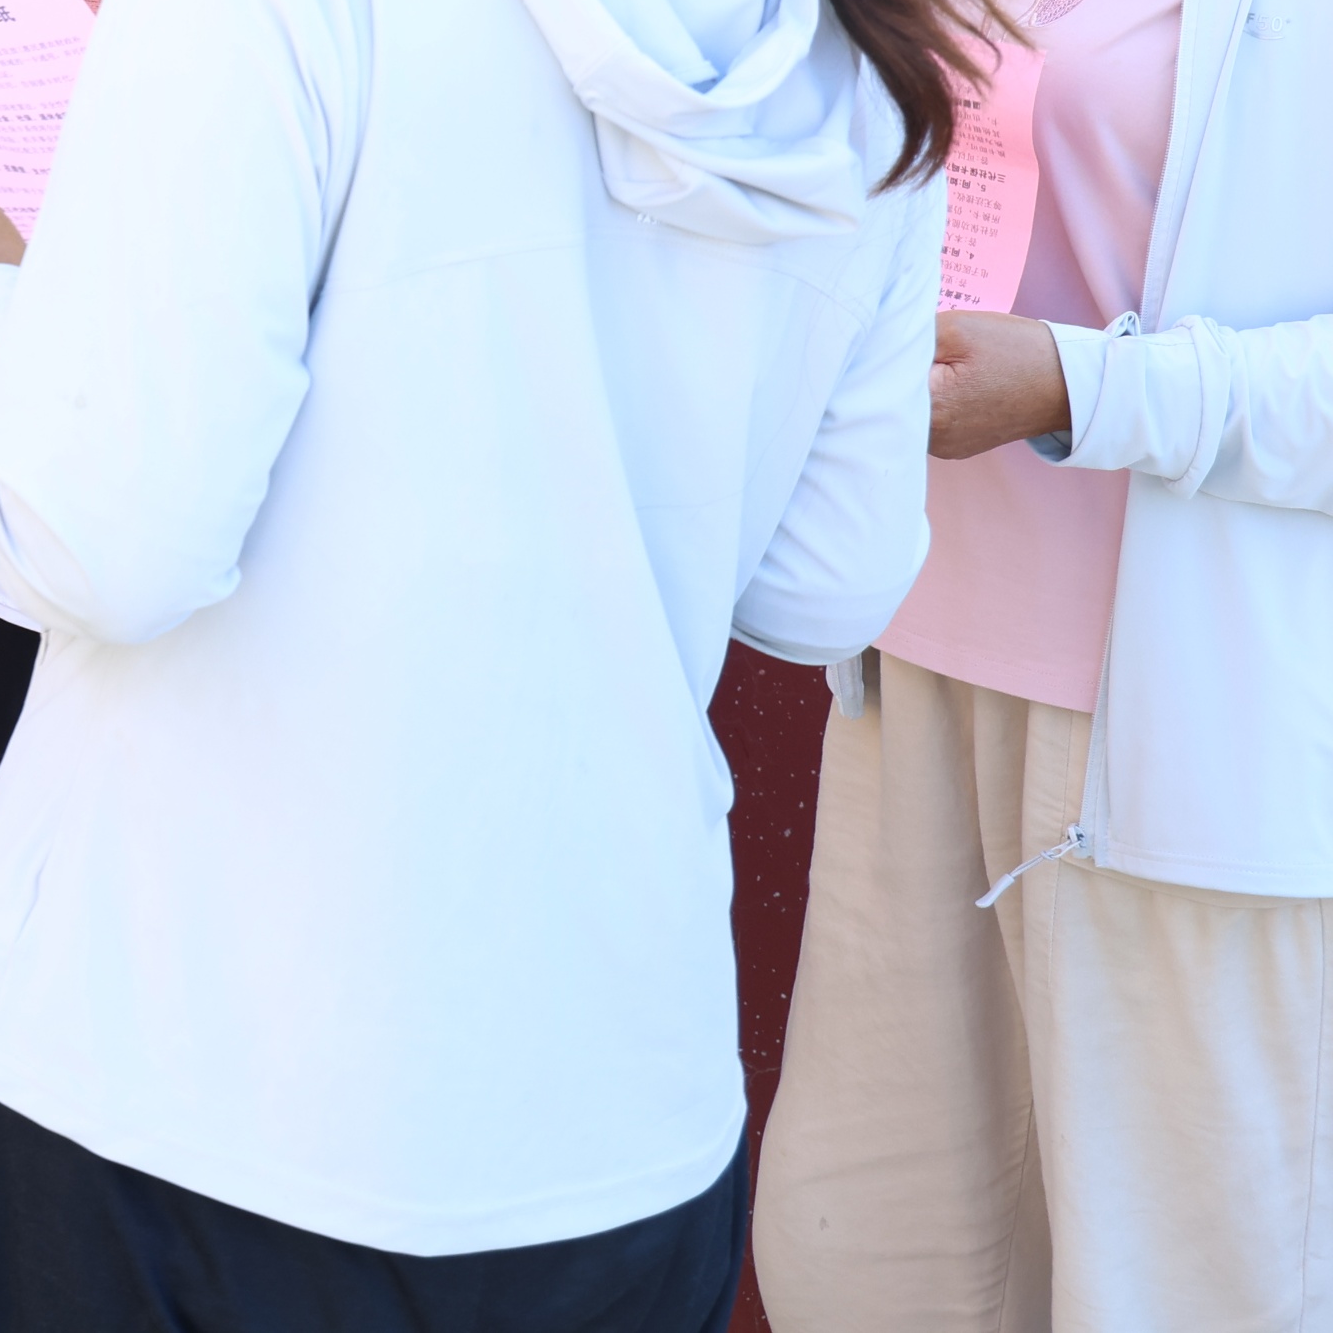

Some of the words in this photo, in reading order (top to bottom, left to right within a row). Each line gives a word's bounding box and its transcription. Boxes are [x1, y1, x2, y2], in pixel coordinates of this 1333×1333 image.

[947, 163, 1006, 183] 三代社保卡吗?
[947, 176, 986, 192] 5、问:如
